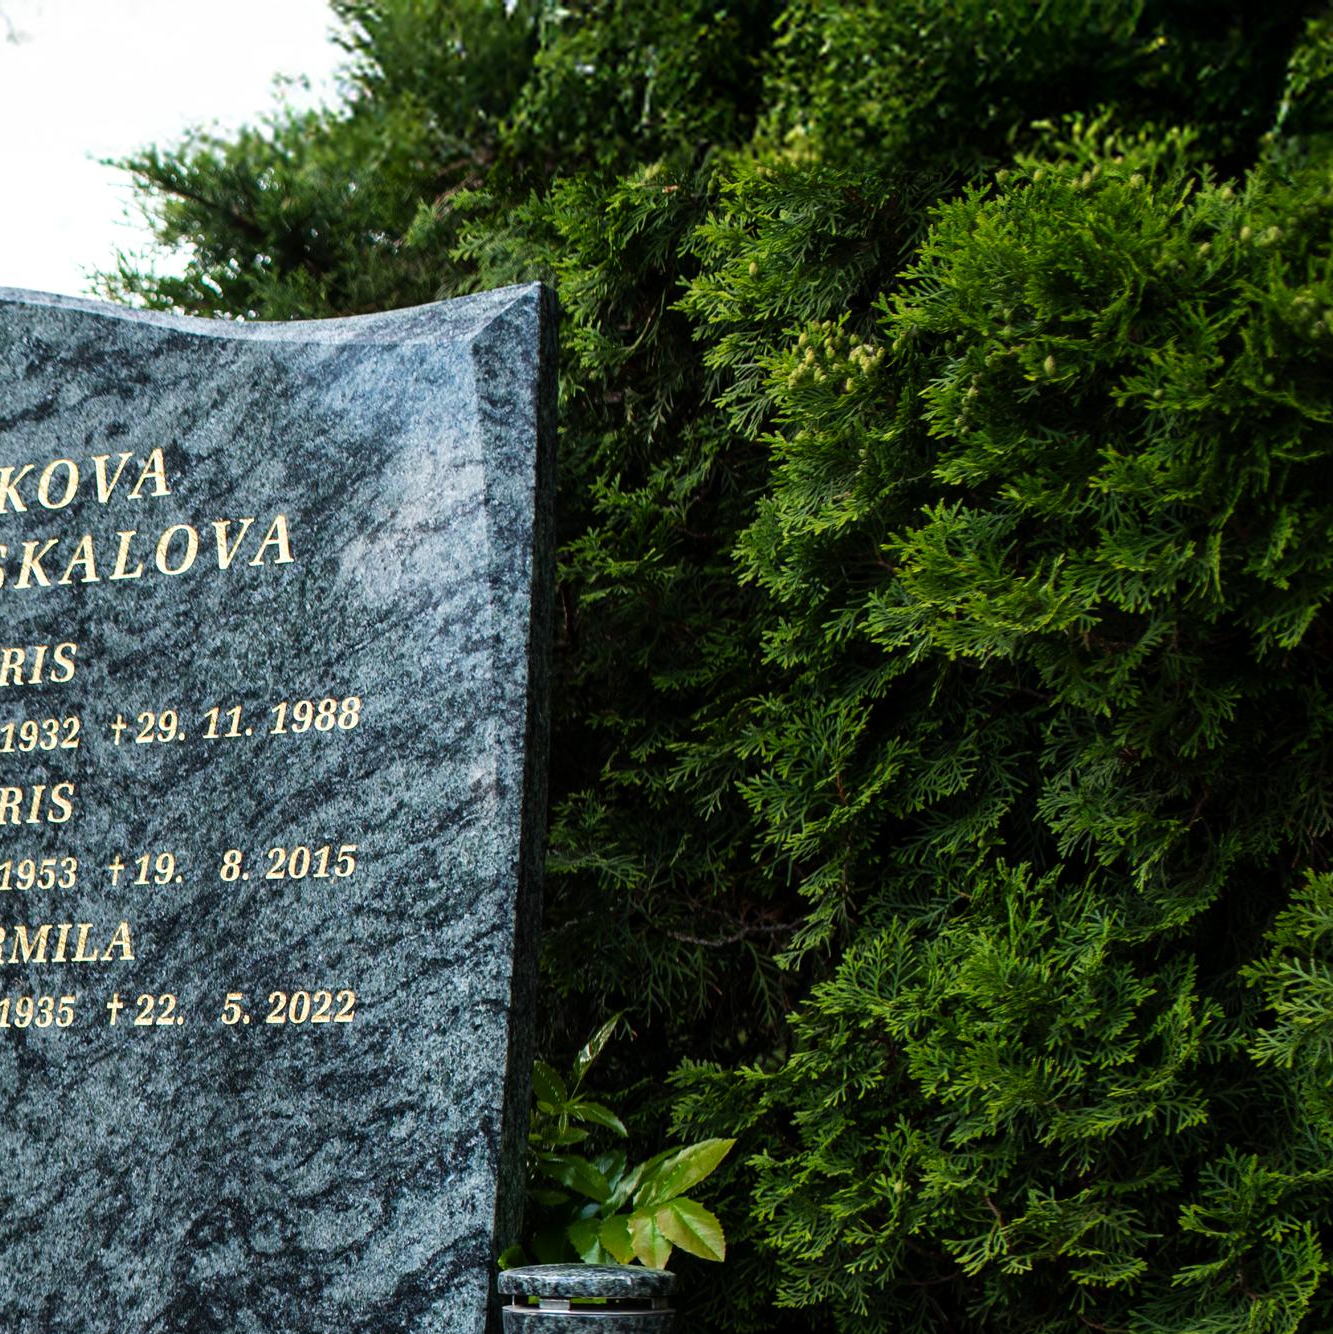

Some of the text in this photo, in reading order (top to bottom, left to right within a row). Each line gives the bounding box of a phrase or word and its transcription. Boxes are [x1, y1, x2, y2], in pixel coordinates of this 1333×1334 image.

[0, 715, 82, 753] 1932
[204, 703, 255, 738] 11.
[269, 695, 363, 734] 1988
[219, 847, 251, 882] 8.
[265, 843, 359, 880] 2015
[220, 991, 253, 1025] 5.
[265, 988, 358, 1025] 2022
